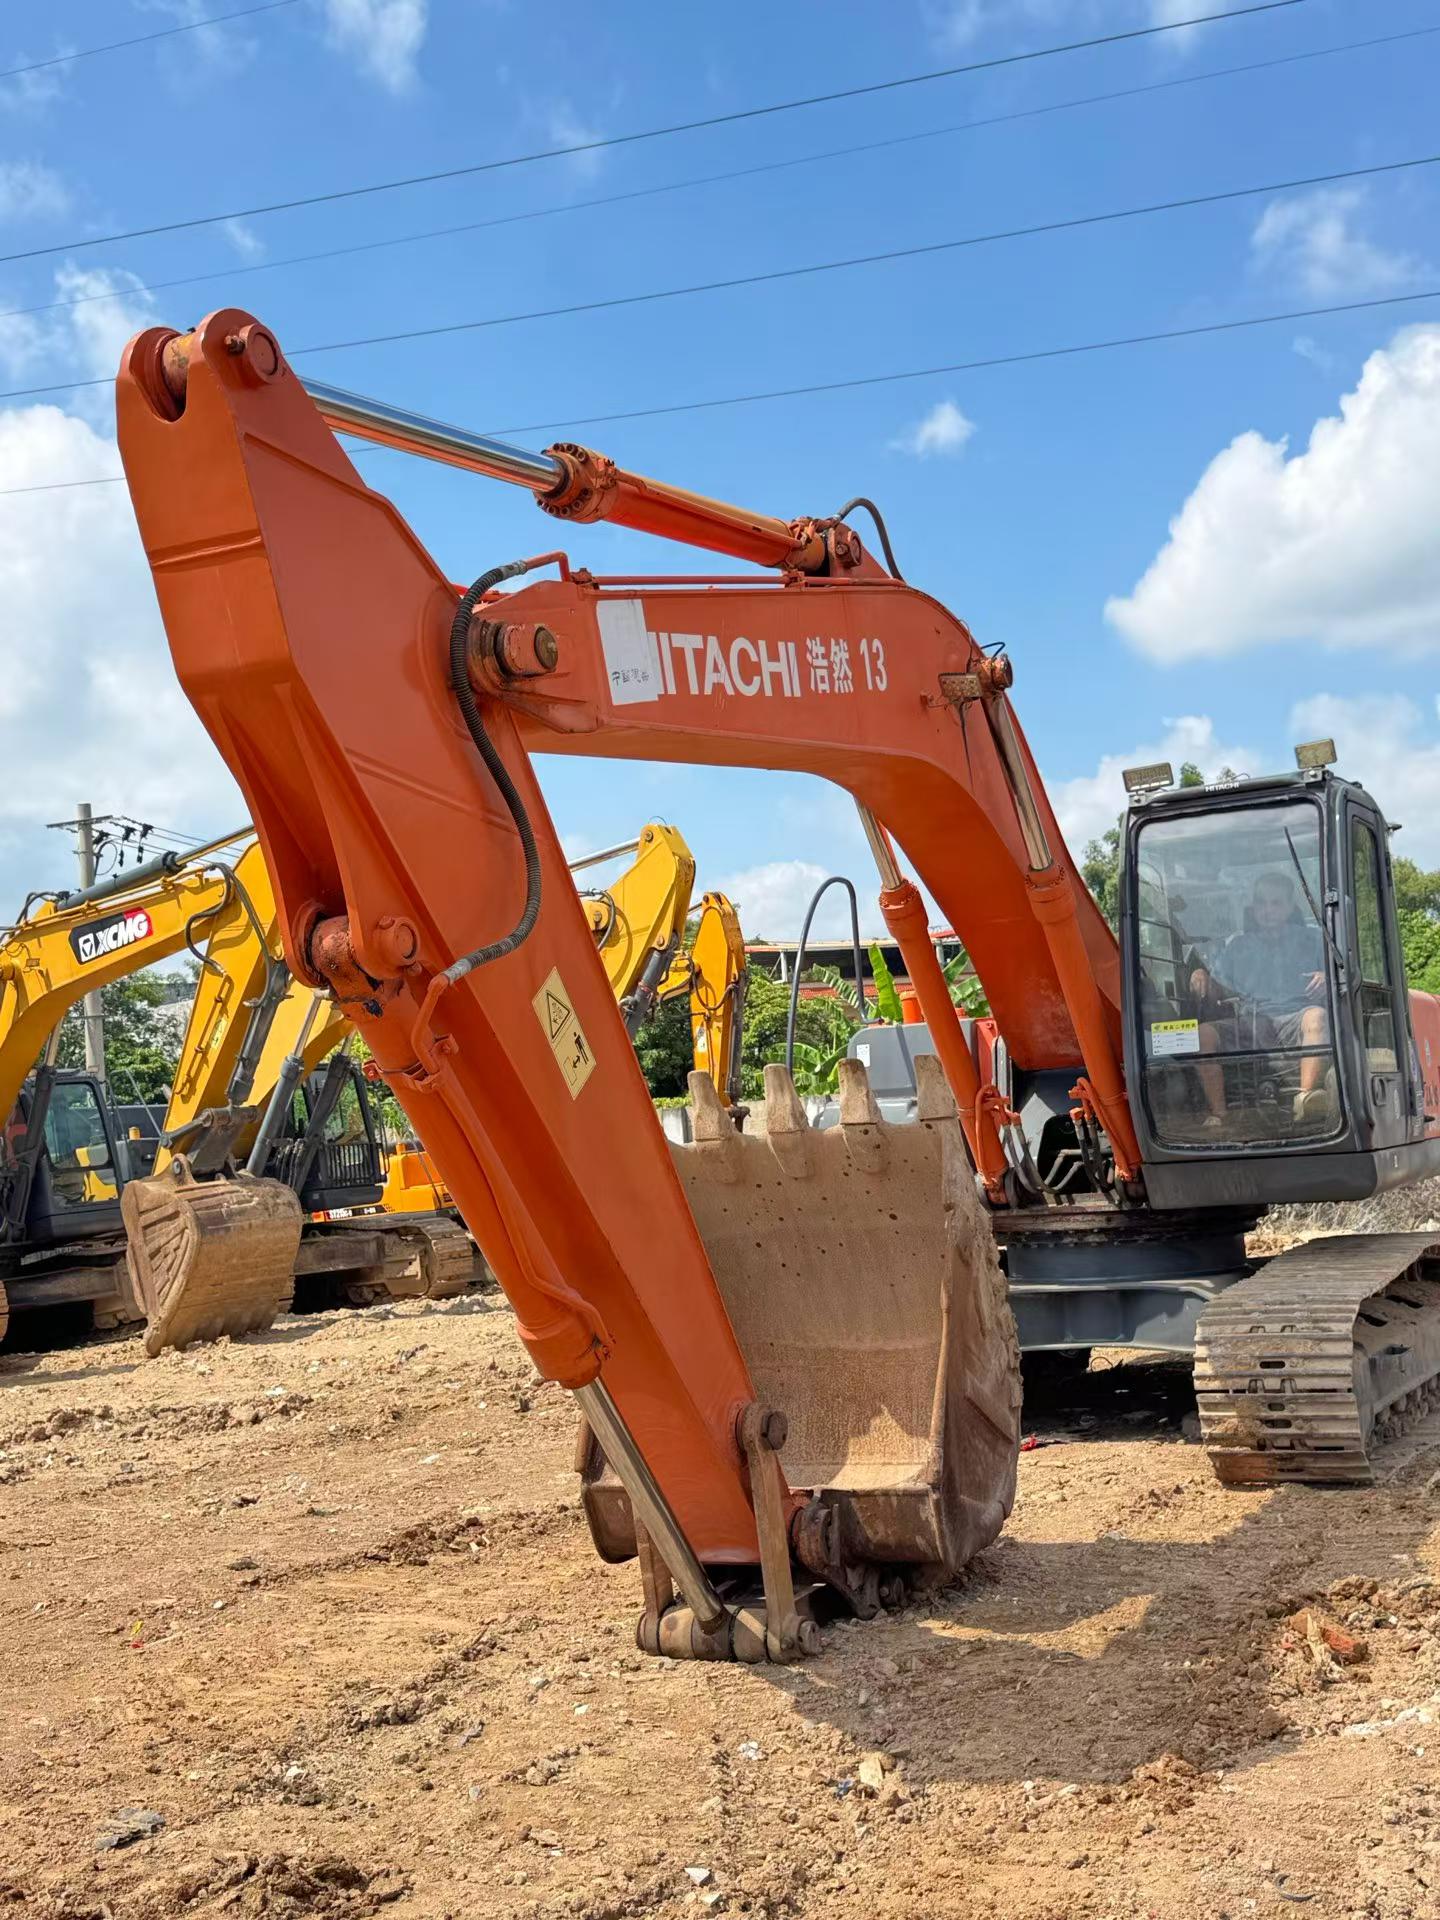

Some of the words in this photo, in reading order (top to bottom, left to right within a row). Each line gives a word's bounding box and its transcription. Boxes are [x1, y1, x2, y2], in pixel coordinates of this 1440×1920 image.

[805, 636, 854, 694] 浩然
[859, 638, 888, 692] 13
[1204, 781, 1240, 793] HITACHI
[96, 913, 148, 955] XCMG
